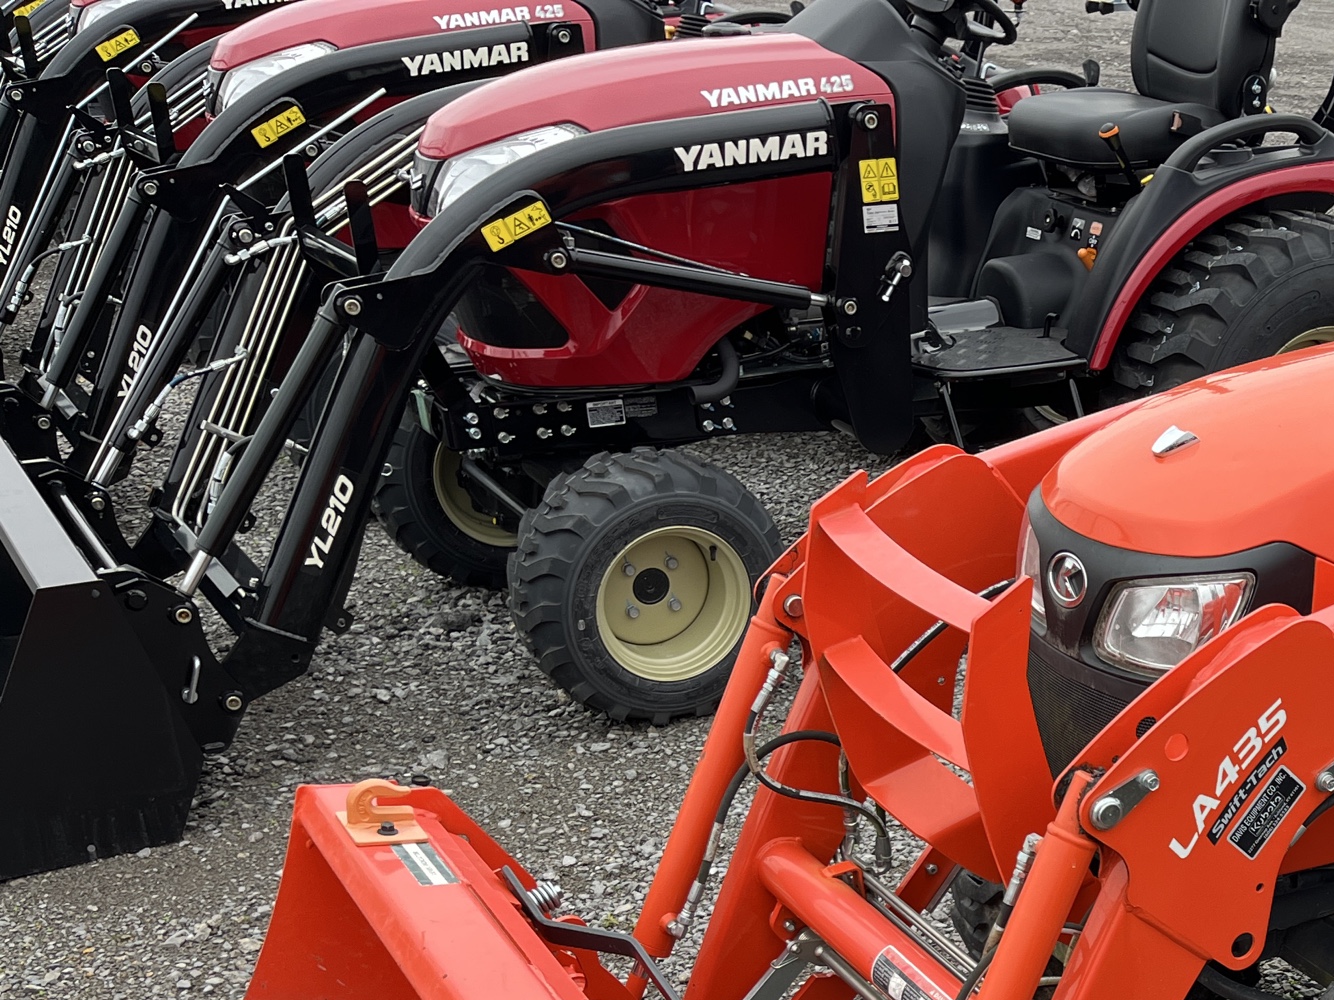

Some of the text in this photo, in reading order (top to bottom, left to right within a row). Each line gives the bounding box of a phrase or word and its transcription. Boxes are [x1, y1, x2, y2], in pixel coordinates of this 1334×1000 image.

[433, 4, 565, 30] YANMAR 425
[400, 41, 529, 77] YANMAR
[700, 74, 854, 108] YANMAR 425
[674, 130, 828, 172] YANMAR
[304, 474, 354, 569] YL210
[1168, 697, 1288, 860] LA435
[1211, 745, 1284, 840] Swift-Tach
[1231, 823, 1247, 843] DAVIS
[1243, 792, 1270, 826] EQUIPMENT
[1249, 793, 1282, 833] Kubota
